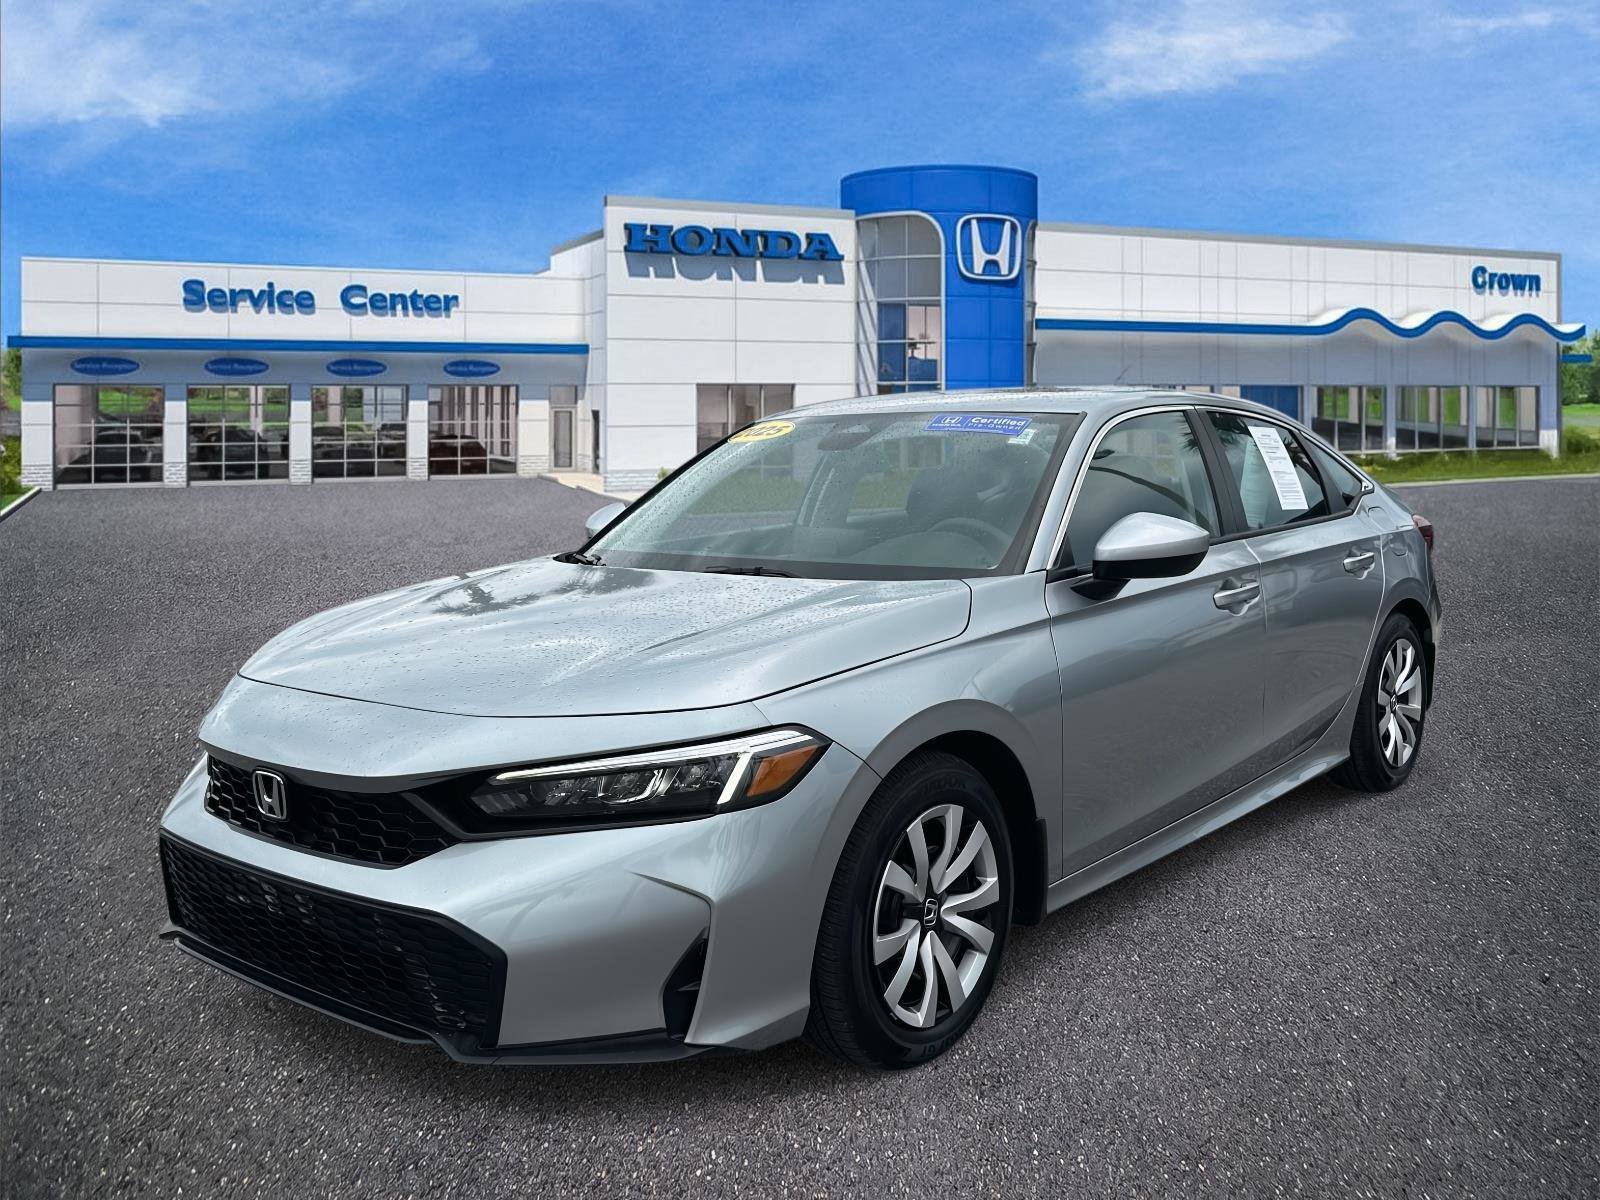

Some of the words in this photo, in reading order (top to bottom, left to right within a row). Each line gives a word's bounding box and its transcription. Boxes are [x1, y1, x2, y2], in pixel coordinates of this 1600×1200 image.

[623, 222, 845, 262] HONDA
[1471, 265, 1542, 292] Crown
[182, 278, 315, 308] Service
[339, 283, 459, 313] Center
[971, 416, 1027, 427] Certified
